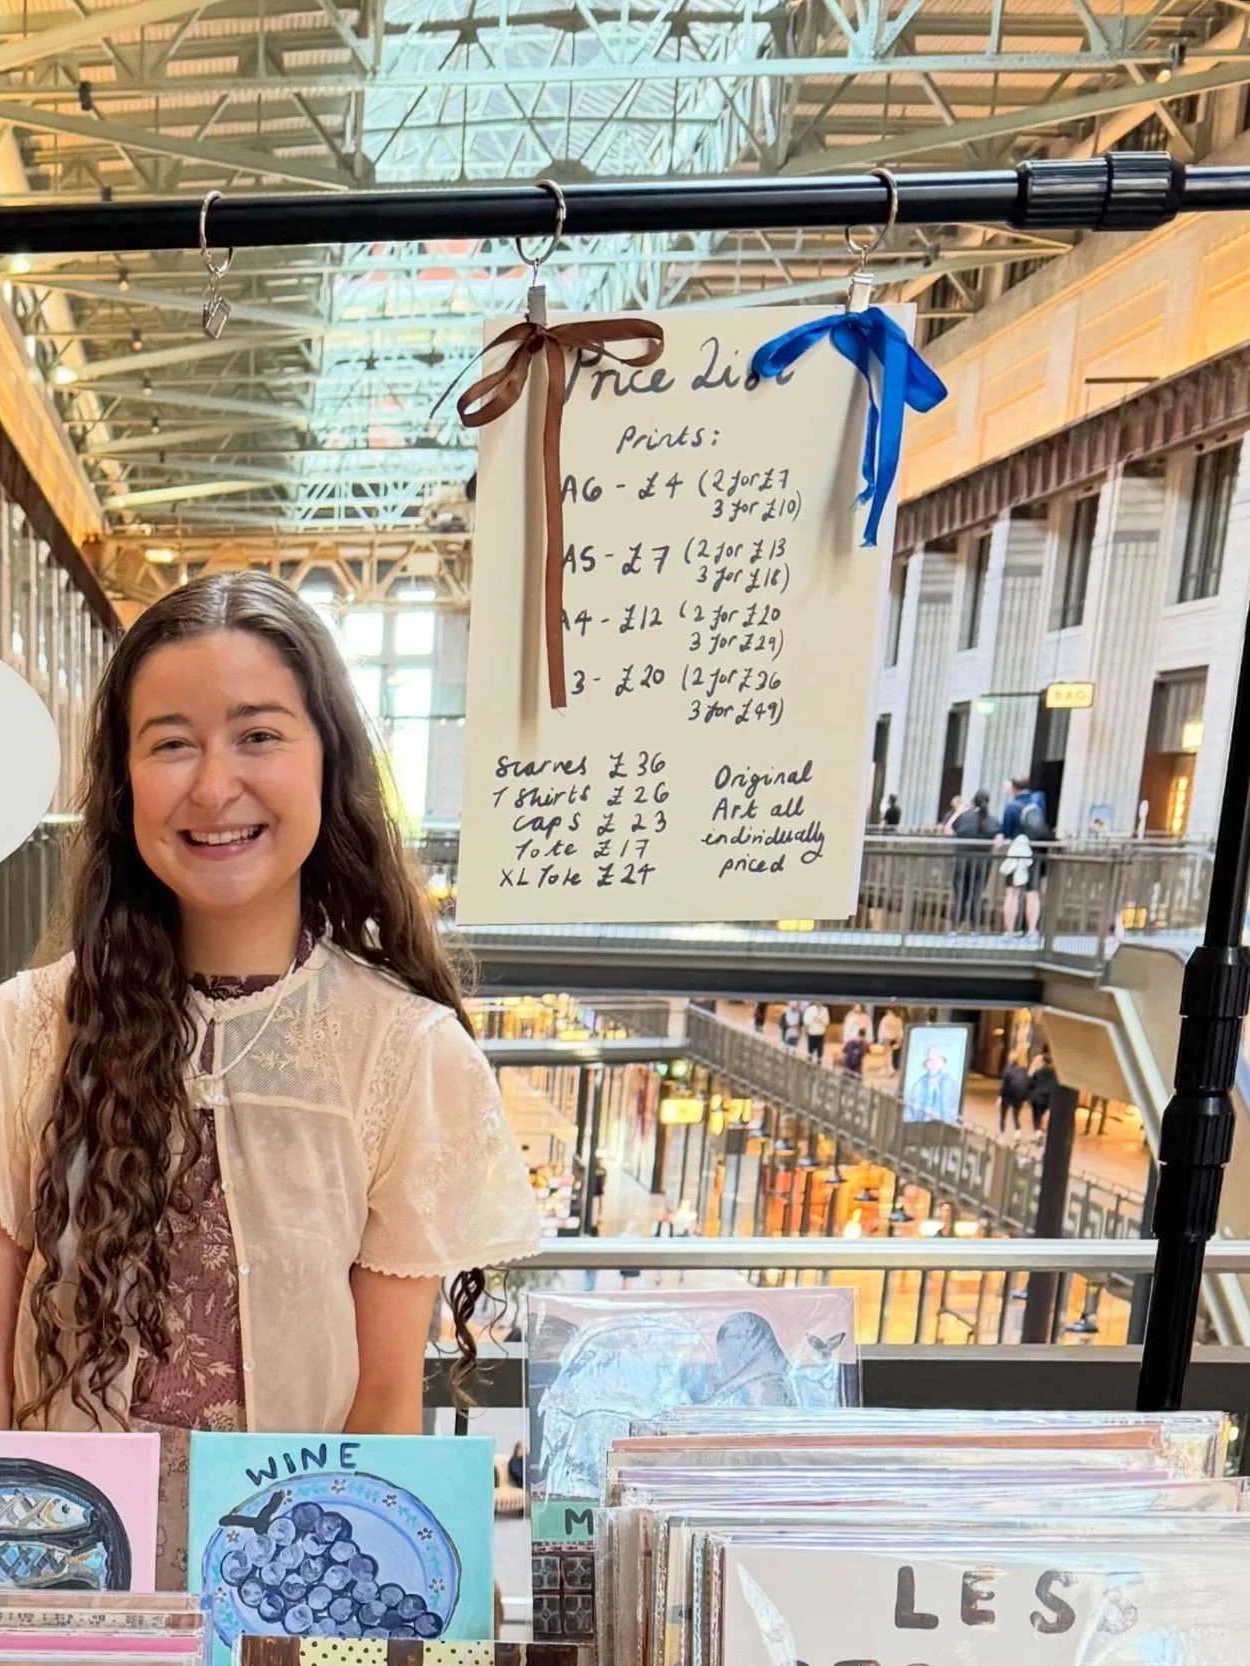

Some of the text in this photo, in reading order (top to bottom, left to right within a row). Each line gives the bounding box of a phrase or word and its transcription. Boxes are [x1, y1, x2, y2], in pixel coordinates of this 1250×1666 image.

[563, 342, 675, 405] Price
[616, 425, 720, 454] Prints:
[561, 474, 602, 504] A6
[727, 470, 759, 496] for
[759, 468, 789, 491] £7
[711, 490, 802, 522] 3 for £10)
[563, 543, 596, 574] A5
[714, 542, 743, 564] for
[750, 538, 786, 563] £13
[696, 566, 708, 583] 3
[713, 566, 742, 592] for
[619, 604, 662, 634] £12
[710, 604, 739, 631] for
[689, 631, 701, 651] 3
[708, 633, 737, 655] for
[615, 664, 665, 696] £20
[706, 668, 737, 697] for
[688, 699, 701, 721] 3
[704, 700, 733, 724] for
[714, 759, 813, 799] Original
[712, 795, 804, 821] Art all
[515, 838, 578, 860] Tote
[701, 820, 825, 864] individually
[499, 867, 529, 887] XL
[718, 853, 786, 878] priced
[245, 1441, 362, 1488] WINE
[564, 1507, 595, 1536] M
